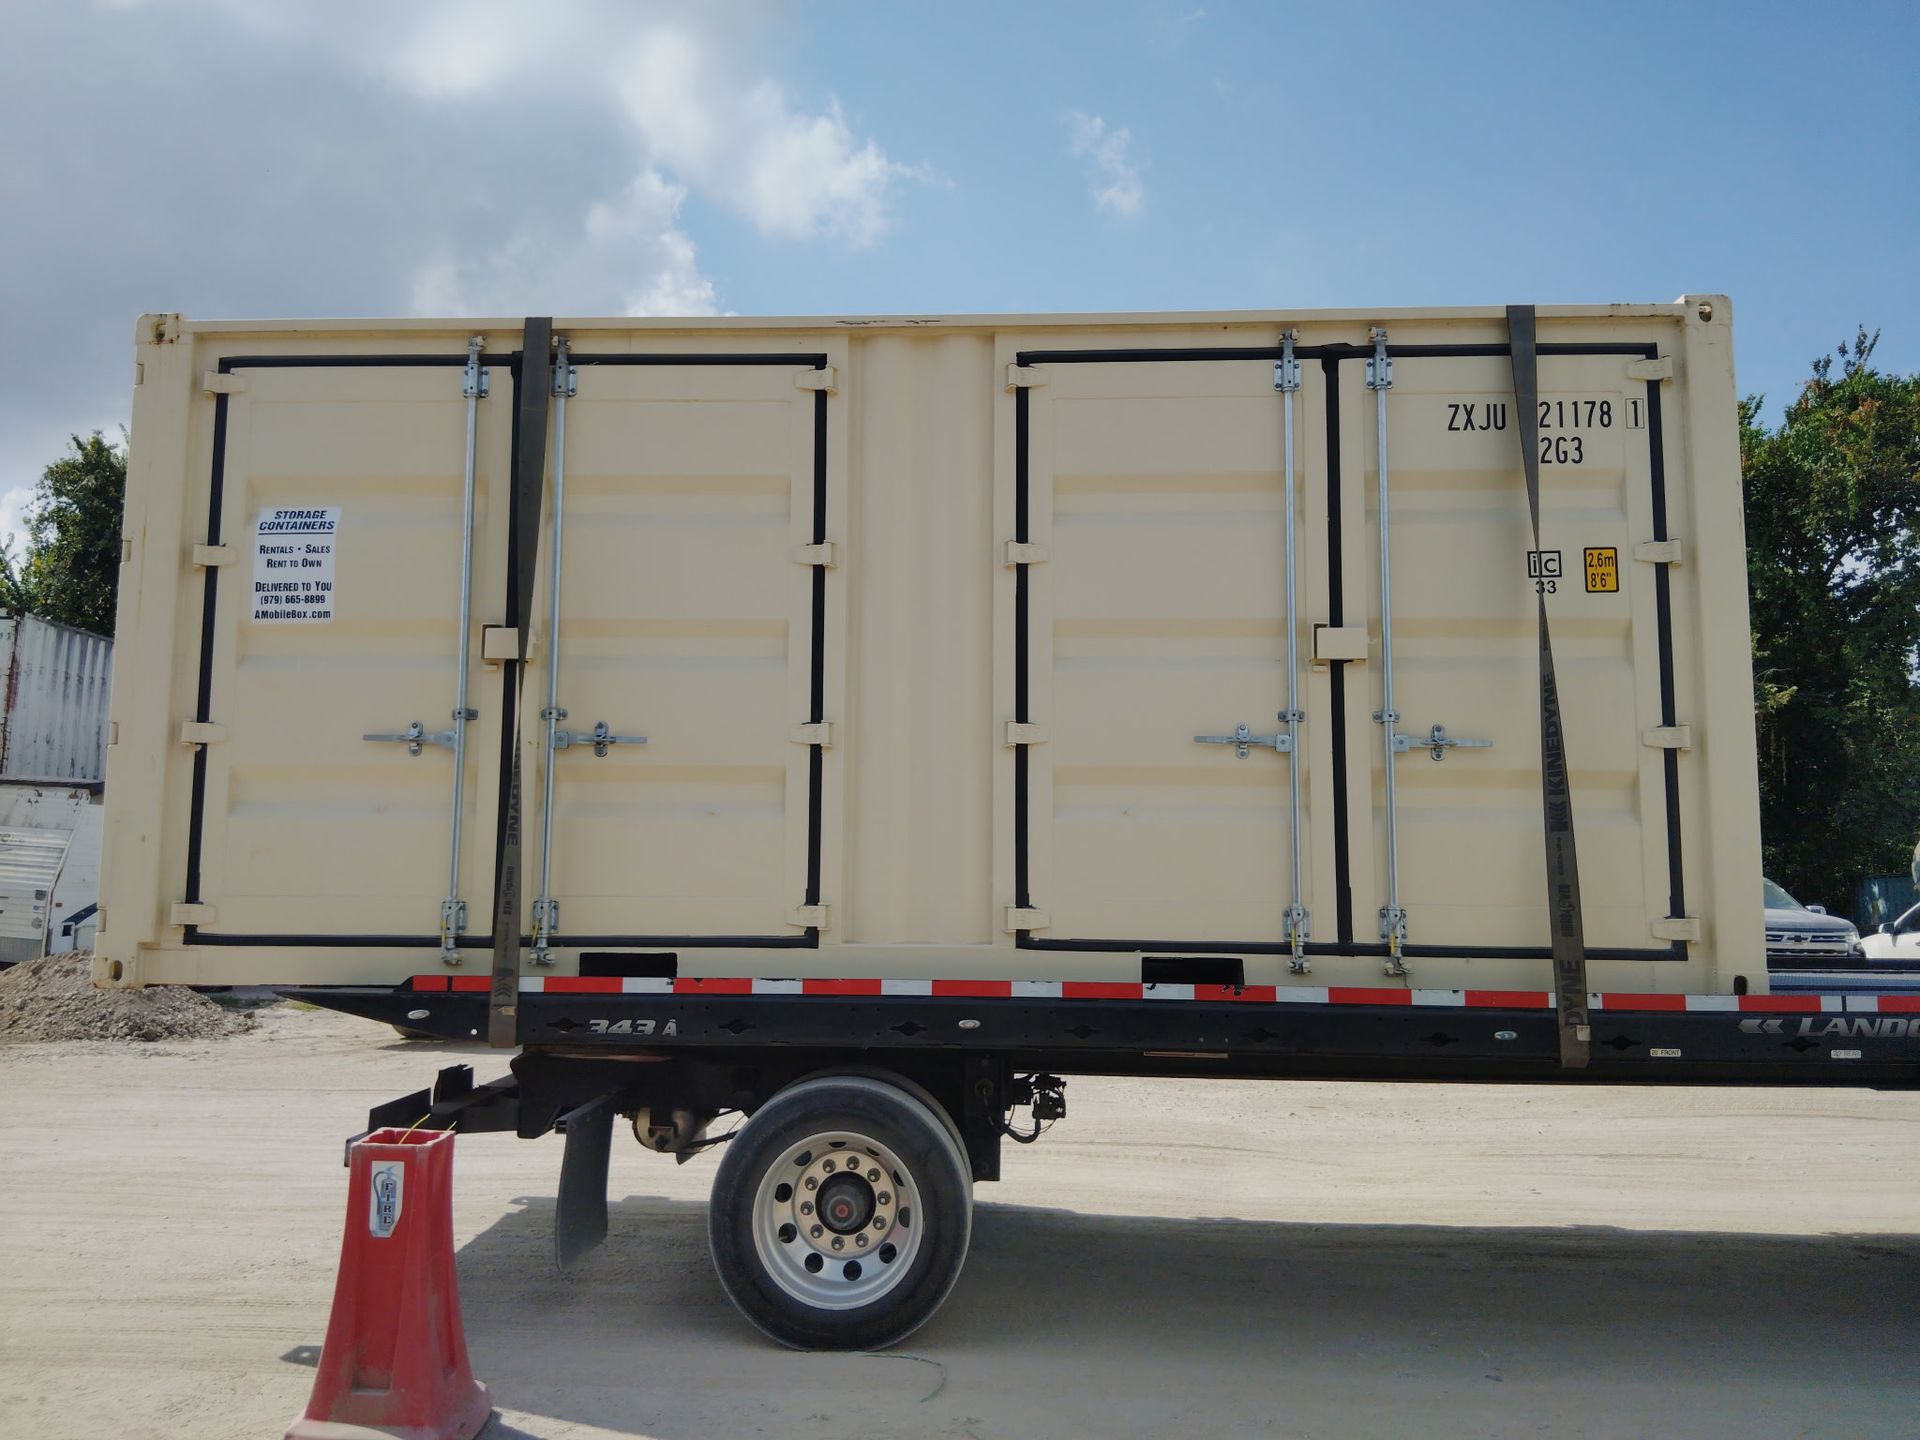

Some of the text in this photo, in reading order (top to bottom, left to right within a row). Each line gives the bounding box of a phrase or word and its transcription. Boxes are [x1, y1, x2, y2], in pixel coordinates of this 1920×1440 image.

[1448, 404, 1506, 431] ZXJU
[1540, 437, 1584, 464] 2G3
[275, 510, 327, 520] STORAGE
[259, 521, 335, 531] CONTAINERS
[1536, 580, 1556, 594] 33
[260, 595, 326, 605] (979) 665-8899
[254, 610, 331, 619] AMobileBox.com
[1541, 672, 1565, 796] KINEDYNE
[585, 1019, 657, 1035] 343
[383, 1182, 393, 1224] FIRE
